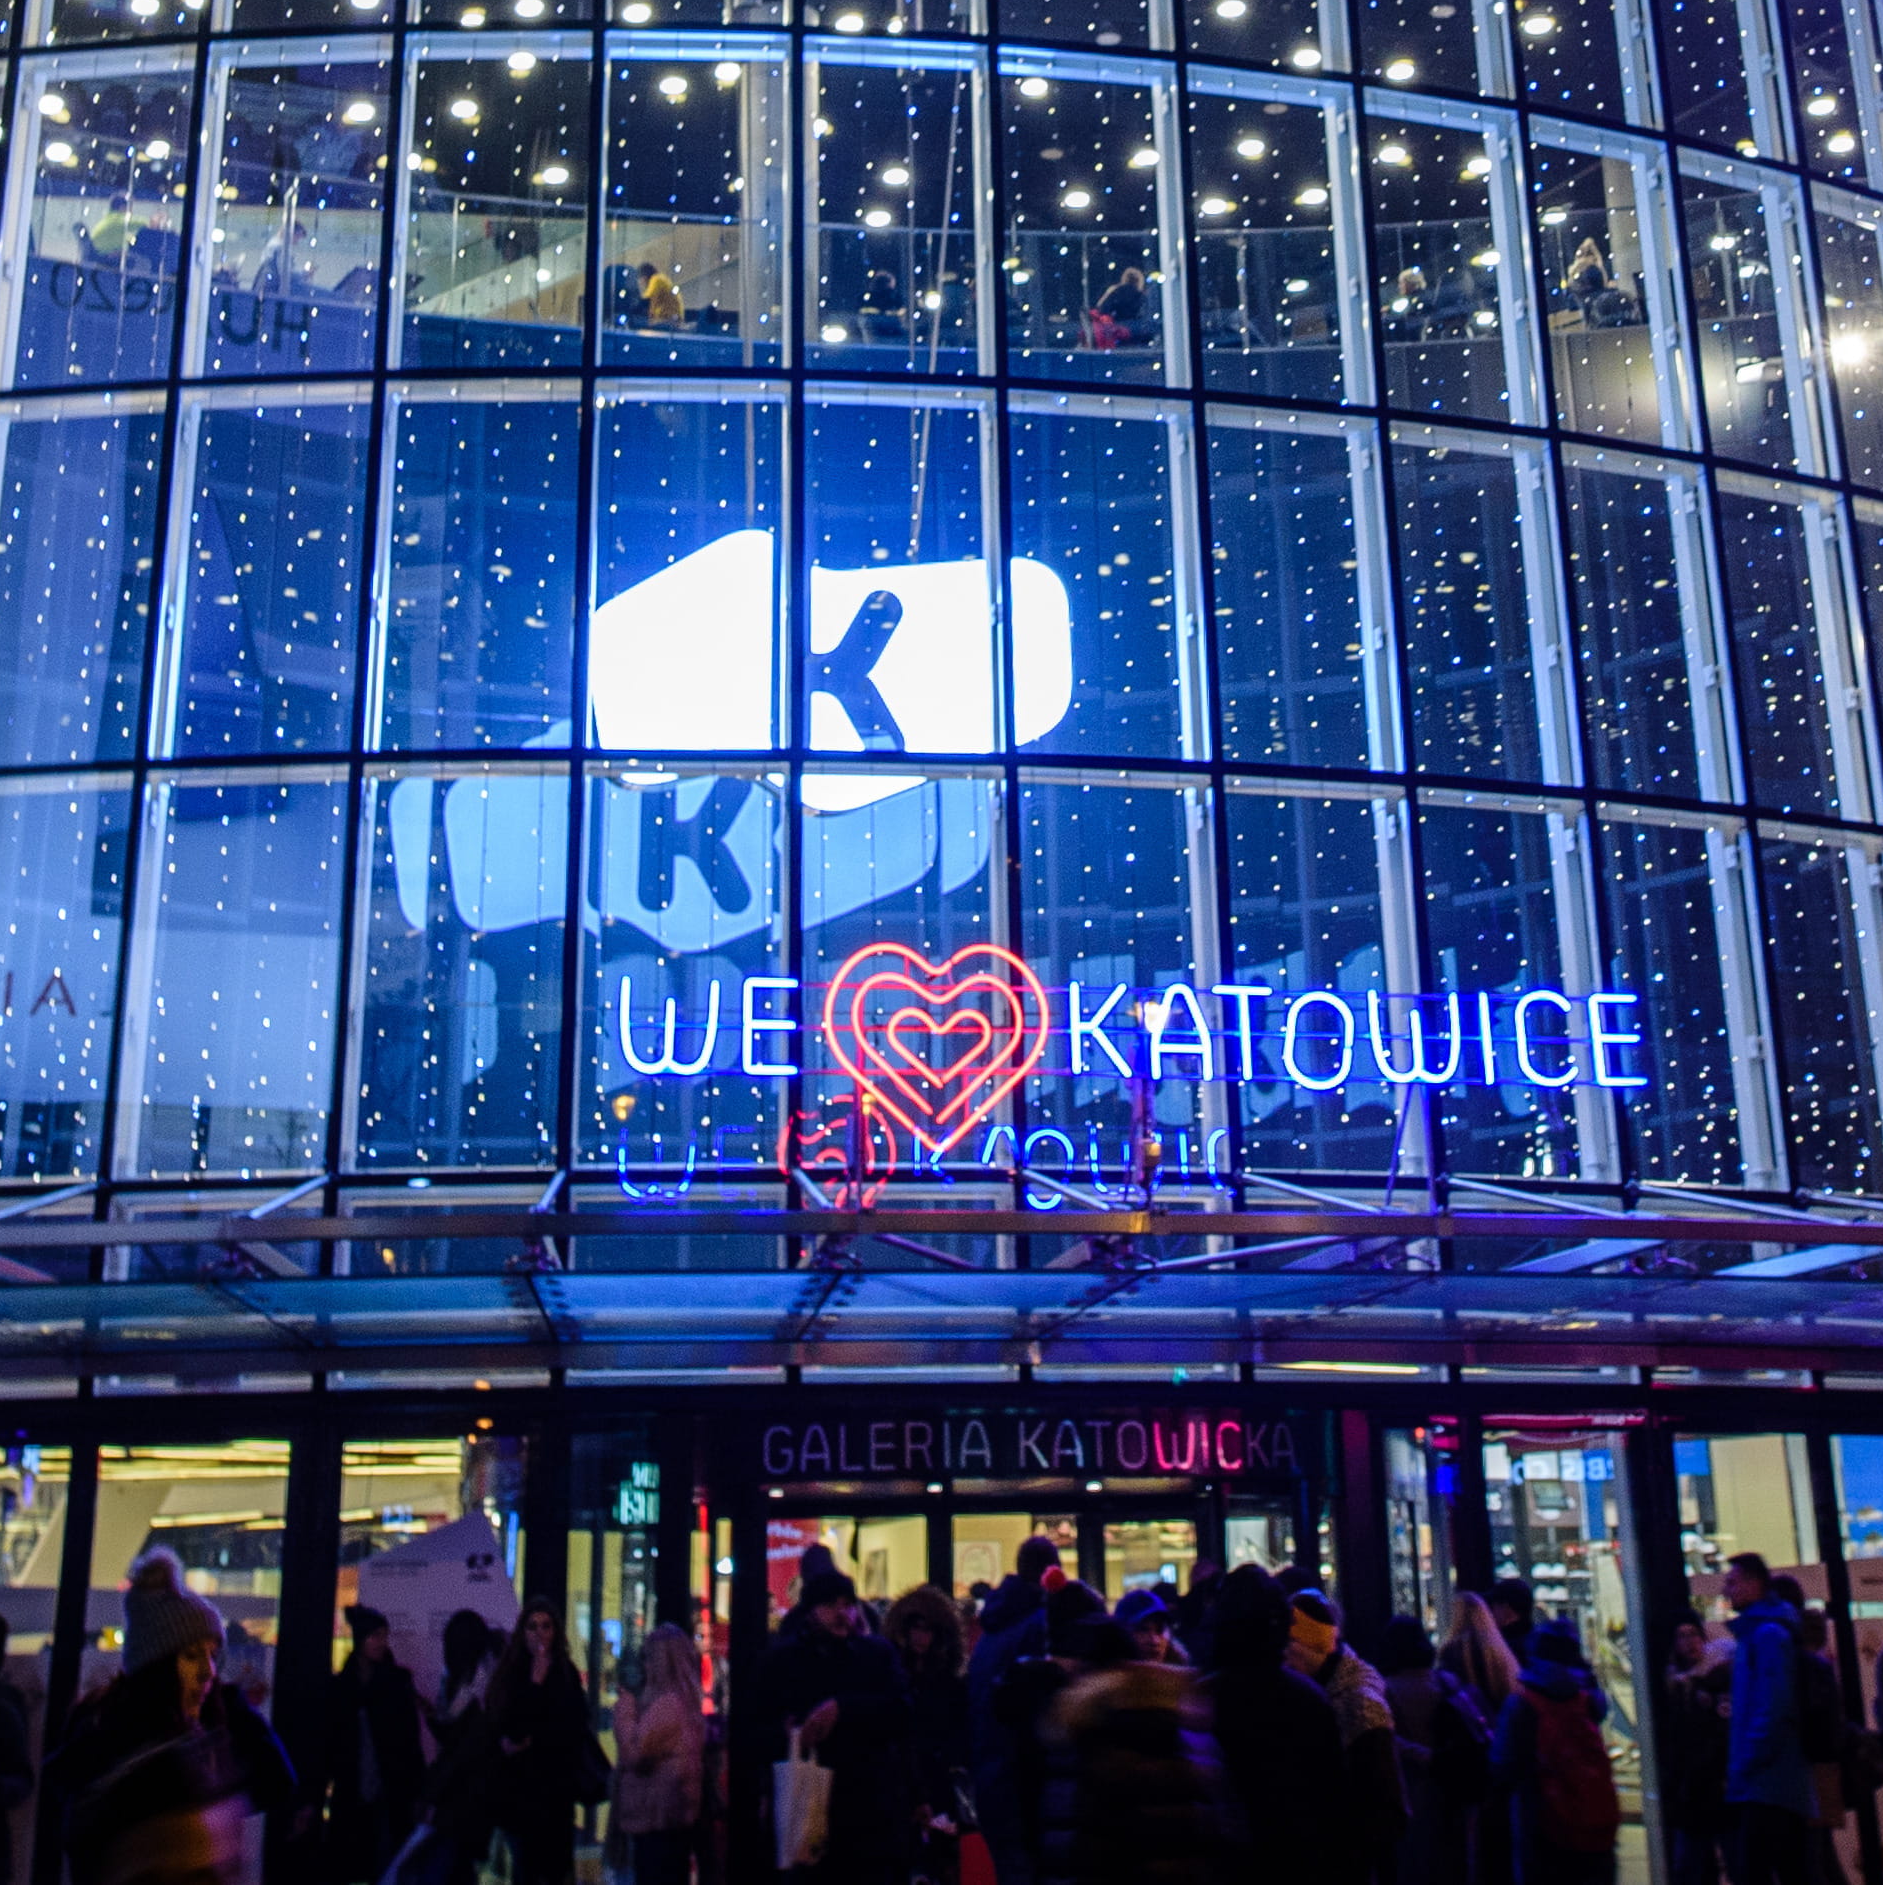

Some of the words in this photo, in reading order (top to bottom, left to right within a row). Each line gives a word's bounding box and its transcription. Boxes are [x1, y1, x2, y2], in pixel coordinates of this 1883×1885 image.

[619, 974, 800, 1076] WE
[1068, 980, 1650, 1092] KATOWICE
[762, 1420, 994, 1475] GALERIA
[1018, 1418, 1298, 1471] KATOWICKA
